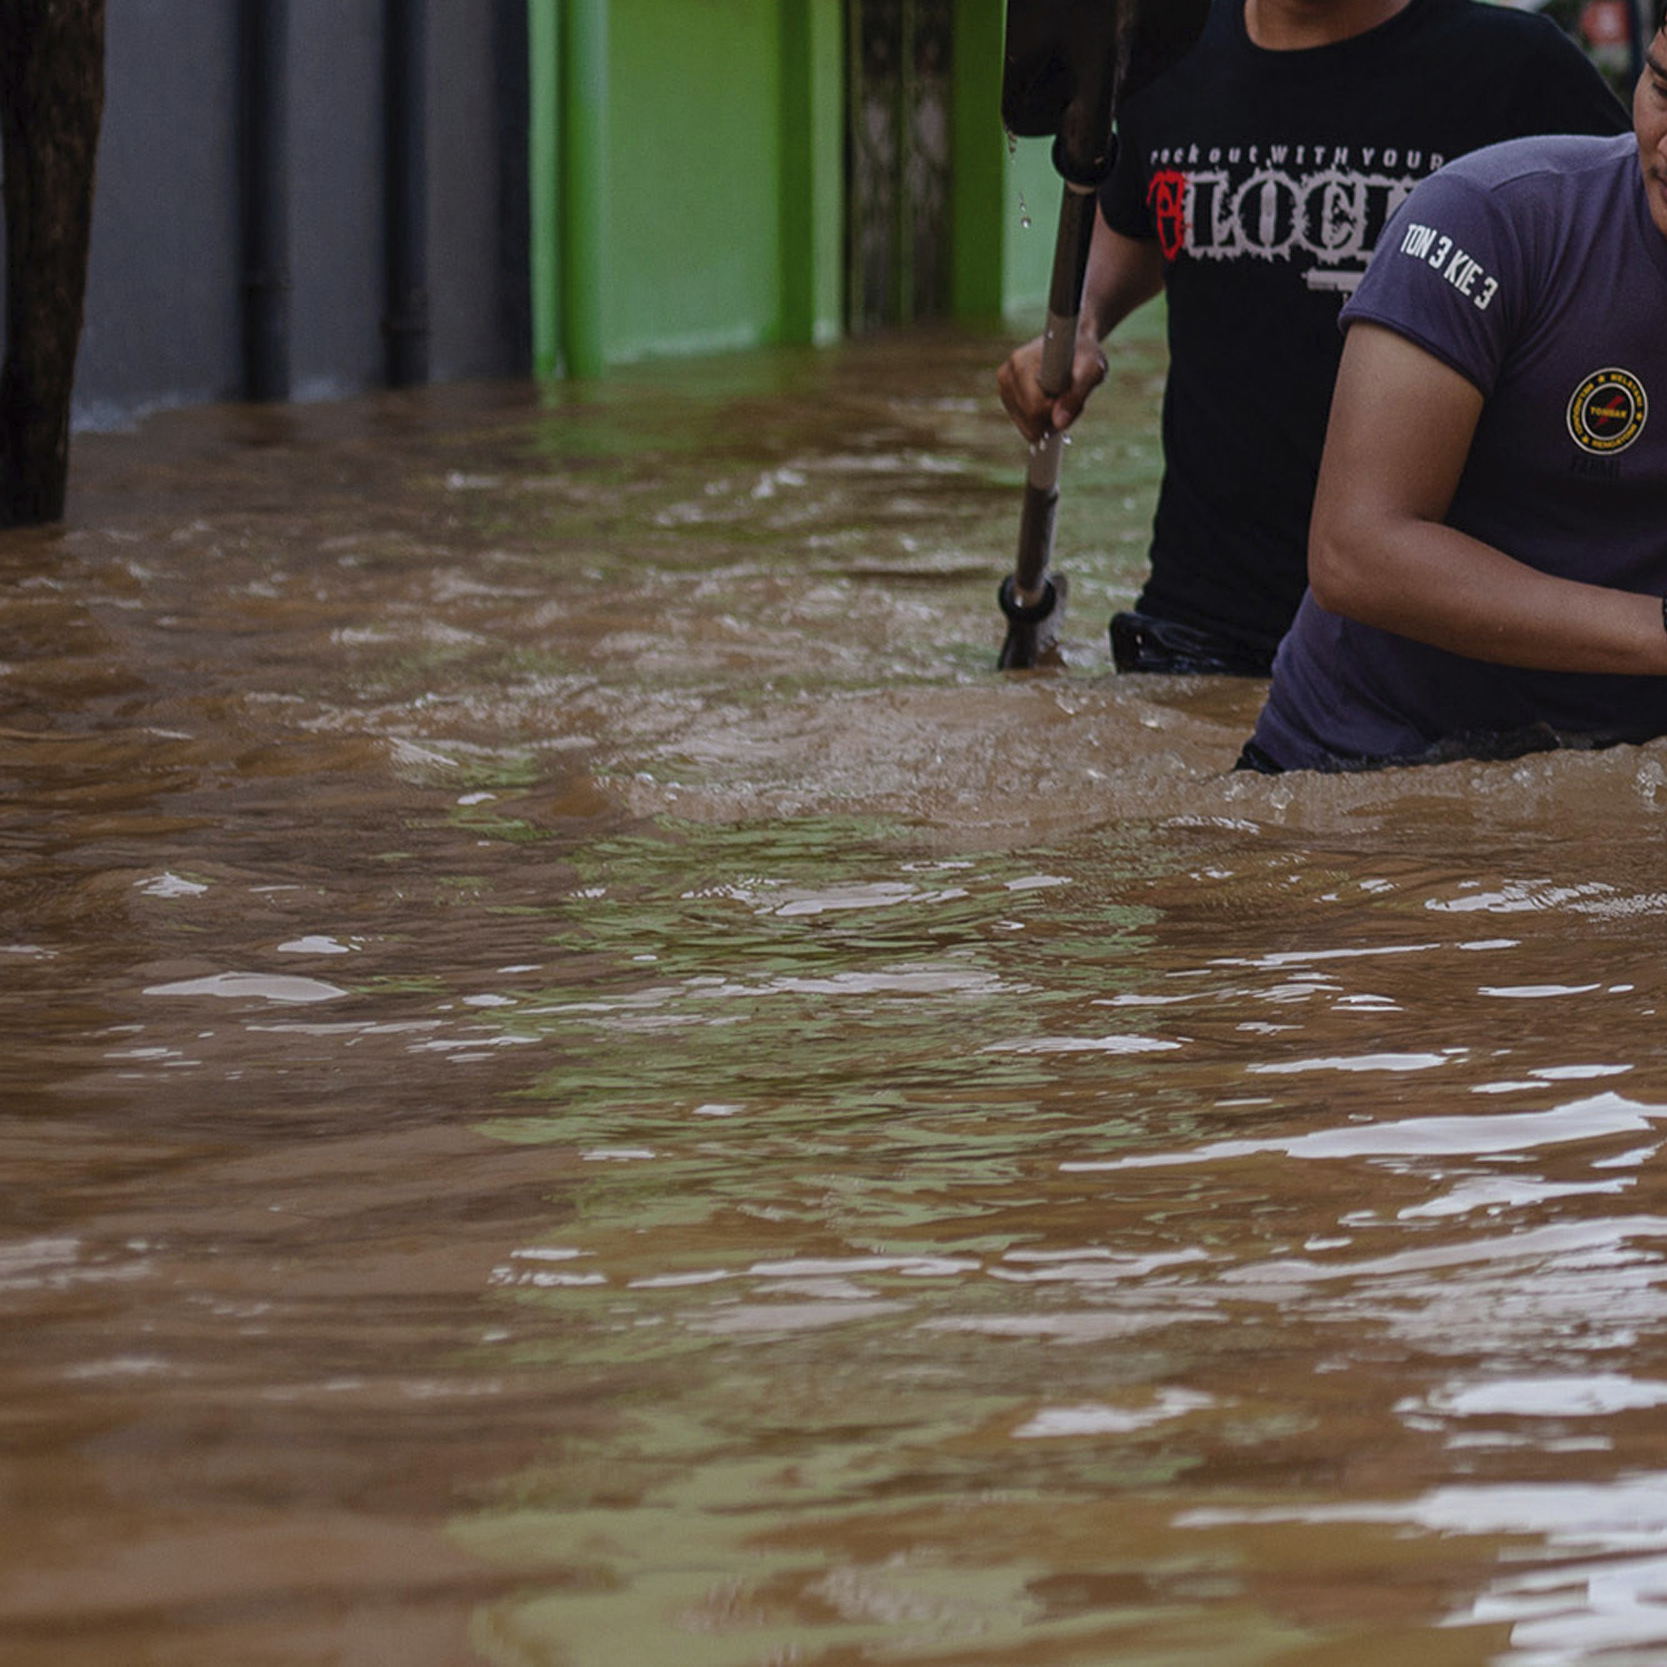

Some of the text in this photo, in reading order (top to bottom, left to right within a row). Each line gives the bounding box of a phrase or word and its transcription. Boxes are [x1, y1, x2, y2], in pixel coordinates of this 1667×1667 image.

[1270, 144, 1349, 165] WITH
[1362, 147, 1444, 171] YOUR
[1400, 223, 1499, 311] TON 3 KIE 3
